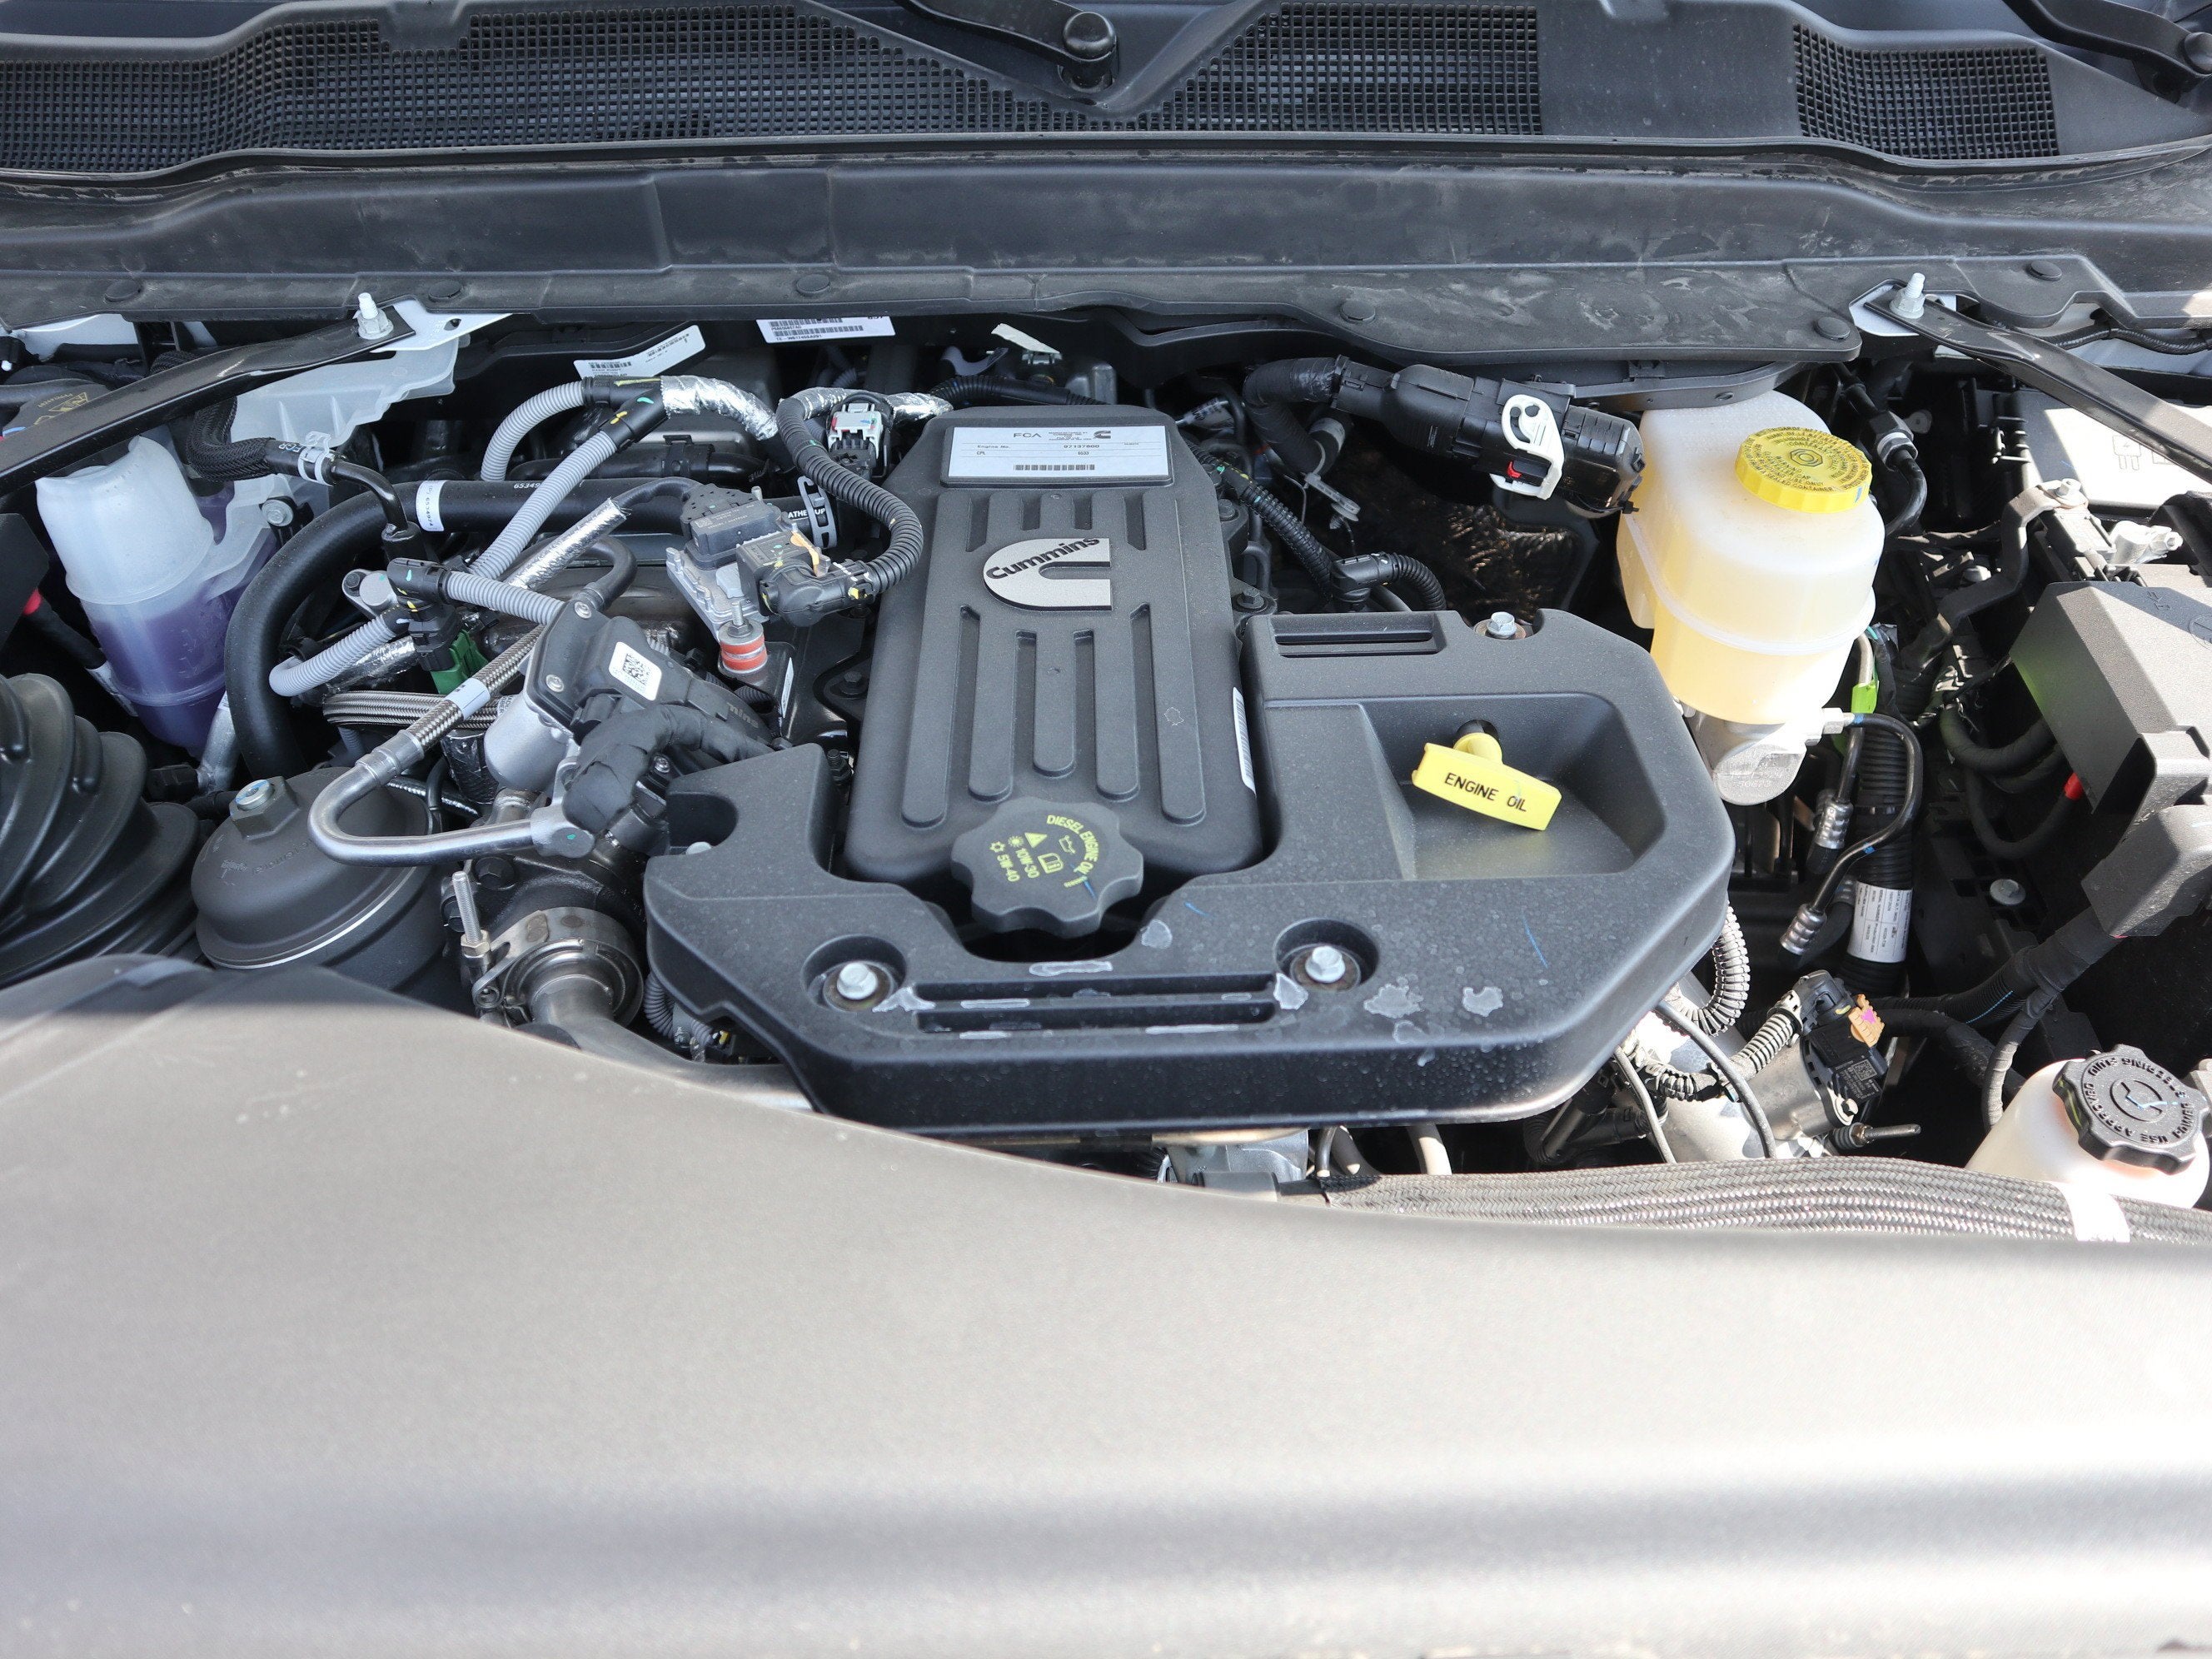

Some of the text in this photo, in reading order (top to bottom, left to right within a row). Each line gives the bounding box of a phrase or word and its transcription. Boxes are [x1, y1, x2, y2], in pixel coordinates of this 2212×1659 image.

[985, 537, 1100, 580] Cummins
[1444, 772, 1527, 812] ENGINE OIL
[1046, 815, 1084, 834] DIESEL
[1079, 830, 1099, 862] ENGINE
[997, 854, 1020, 882] 5W-40
[1015, 848, 1040, 879] 10W-30
[2083, 1082, 2170, 1144] USE APPROVED
[2088, 1057, 2195, 1138] POWER STEERING FLUID
